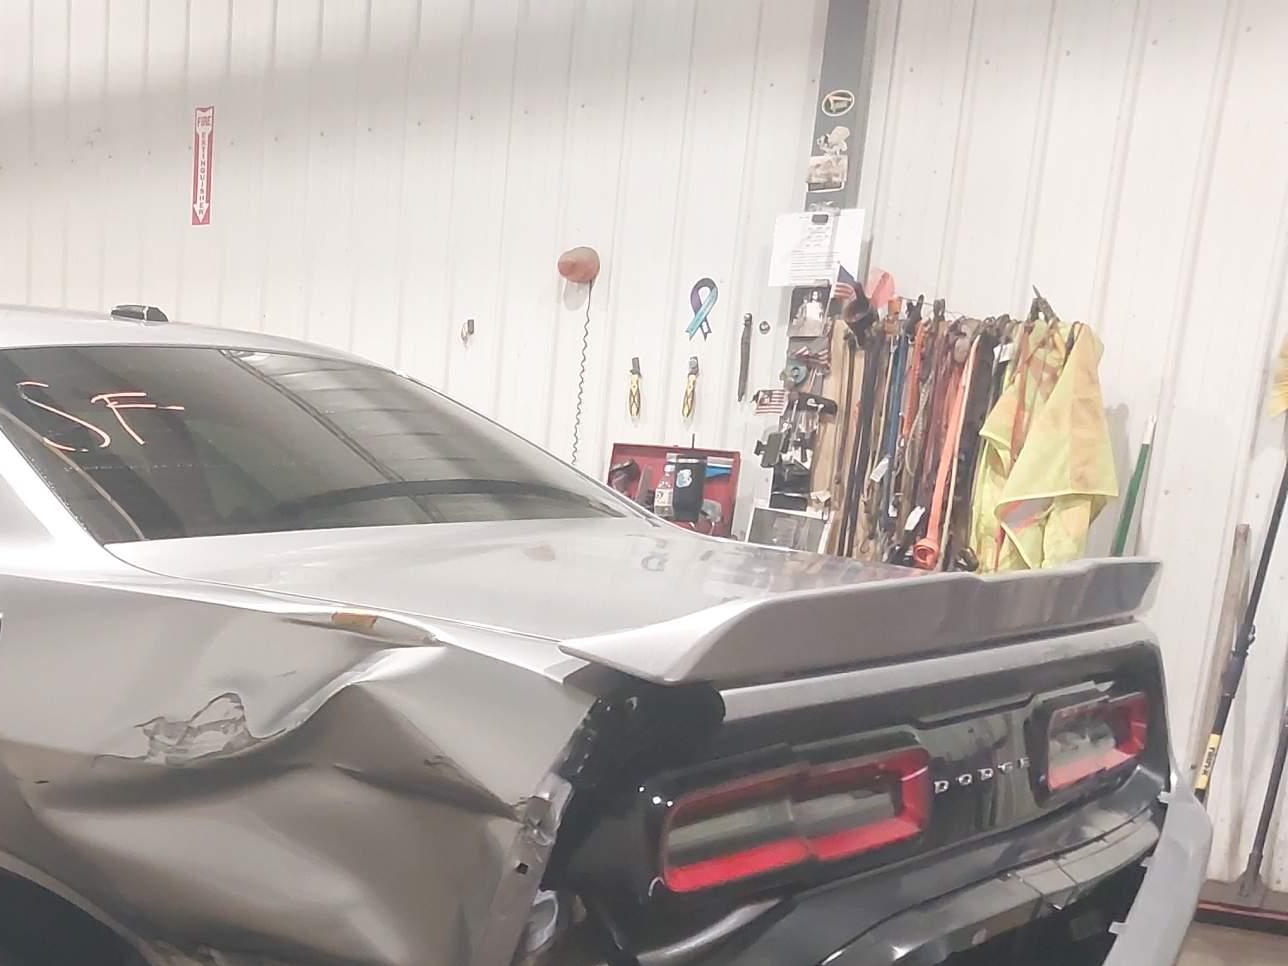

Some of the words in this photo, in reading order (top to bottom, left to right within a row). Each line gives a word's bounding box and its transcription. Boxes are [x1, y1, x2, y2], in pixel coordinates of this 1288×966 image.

[197, 115, 212, 127] FIRE
[198, 131, 207, 215] EXTINGUISHER
[933, 757, 1032, 794] DODGE
